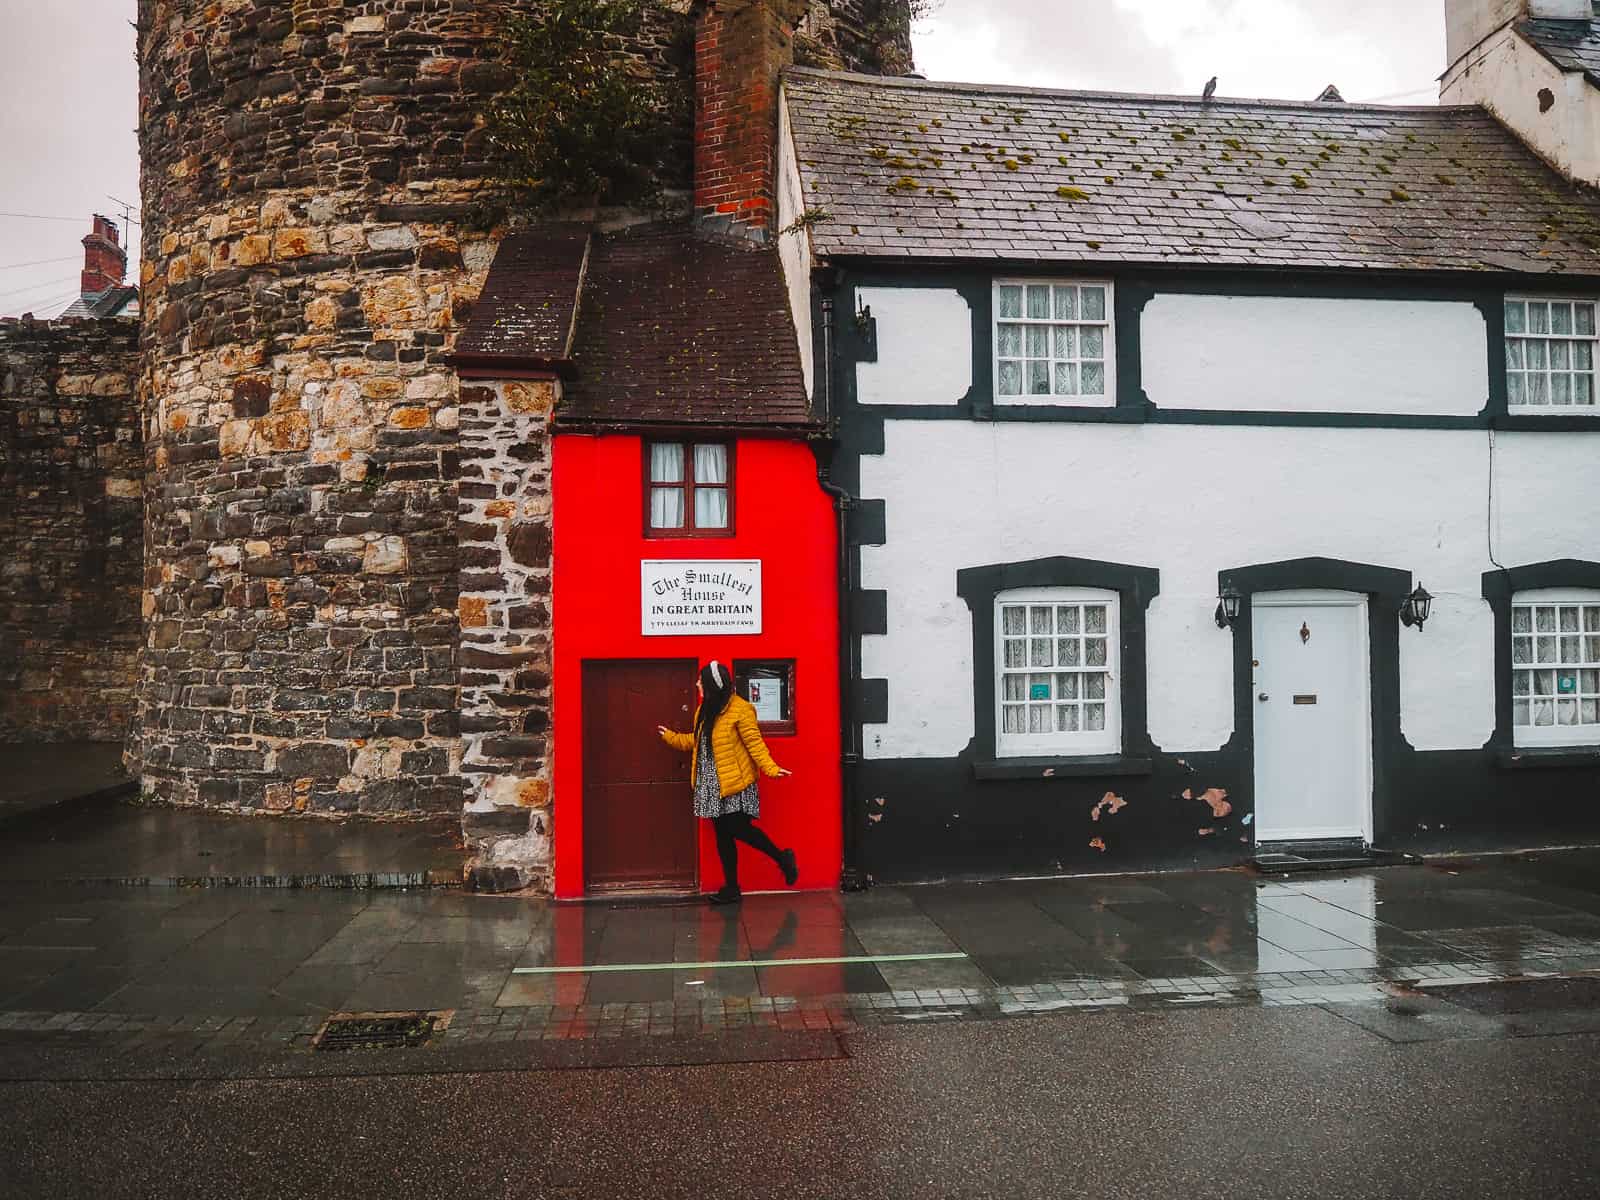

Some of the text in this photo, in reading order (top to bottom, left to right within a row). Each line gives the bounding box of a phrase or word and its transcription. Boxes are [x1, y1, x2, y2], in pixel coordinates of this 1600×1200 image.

[652, 569, 753, 596] The Smallest
[681, 587, 725, 601] House
[652, 604, 753, 615] IN GREAT BRITAIN
